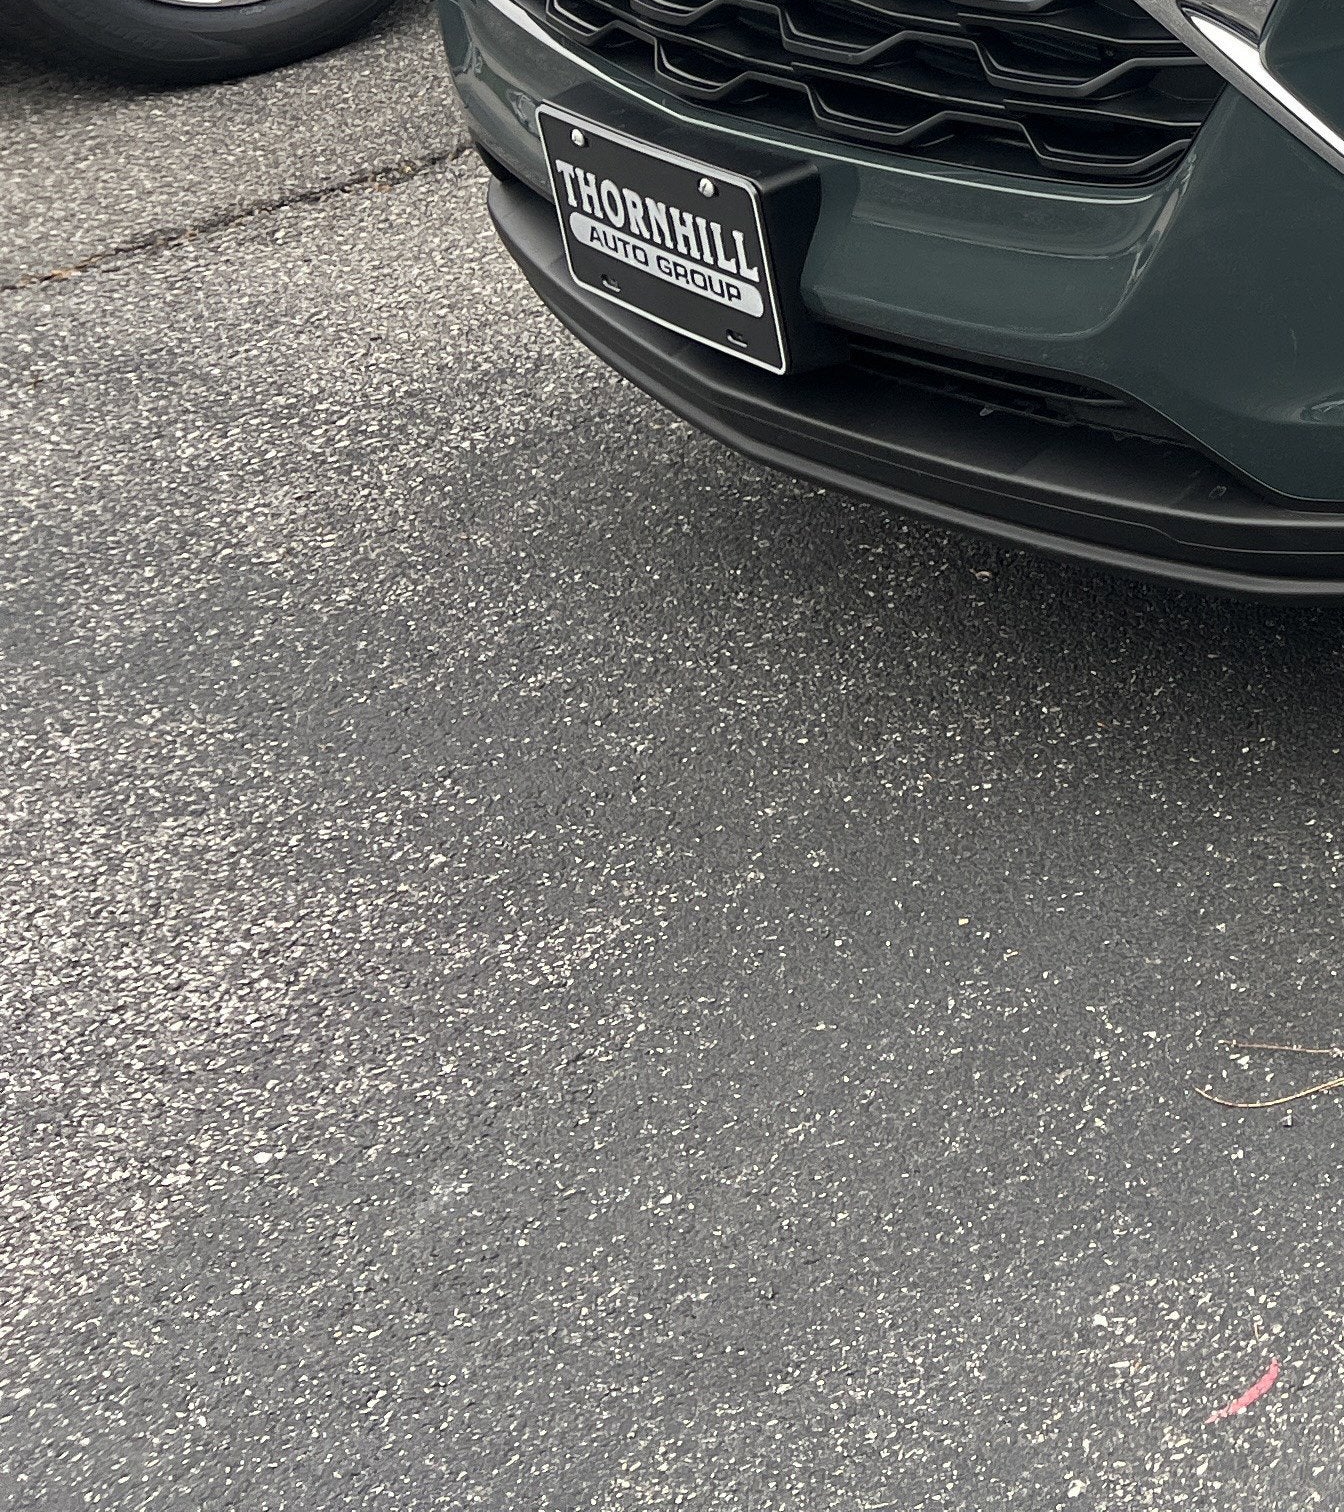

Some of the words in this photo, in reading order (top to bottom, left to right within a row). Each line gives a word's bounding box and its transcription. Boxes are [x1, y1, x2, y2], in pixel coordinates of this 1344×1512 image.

[555, 159, 760, 283] THORNHILL
[589, 225, 649, 267] AUTO
[656, 254, 742, 302] GROUP
